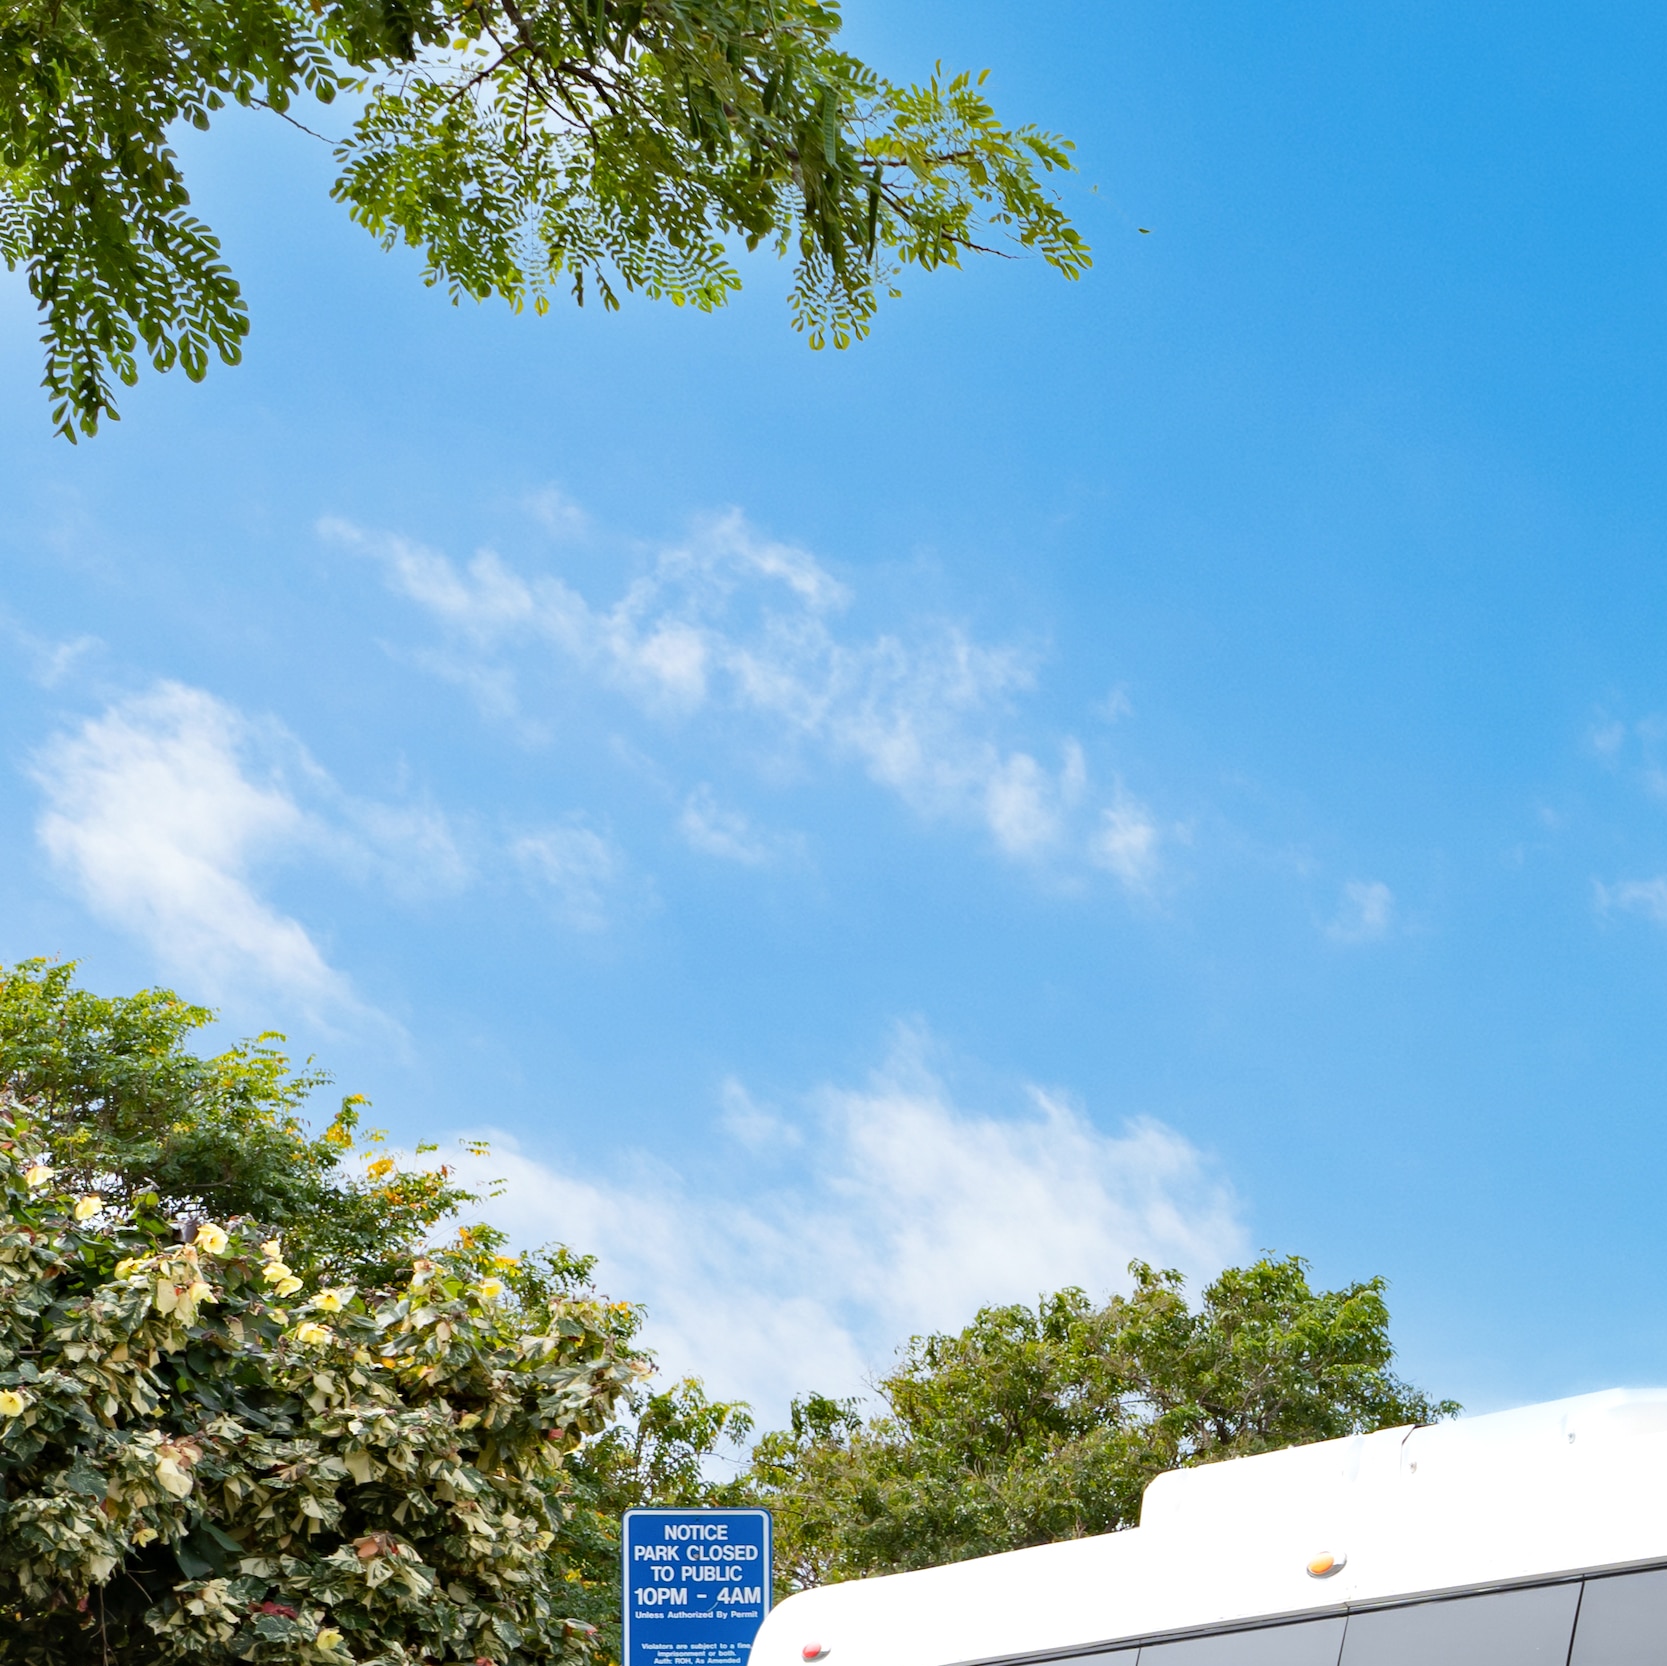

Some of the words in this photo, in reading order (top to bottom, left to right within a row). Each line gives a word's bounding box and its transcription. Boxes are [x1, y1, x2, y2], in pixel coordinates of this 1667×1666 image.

[665, 1525, 728, 1540] NOTICE
[634, 1545, 680, 1561] PARK
[686, 1545, 758, 1560] CLOSED
[651, 1566, 674, 1581] TO
[682, 1566, 742, 1581] PUBLIC
[634, 1587, 687, 1605] 10PM
[717, 1587, 761, 1604] 4AM
[716, 1611, 728, 1619] By
